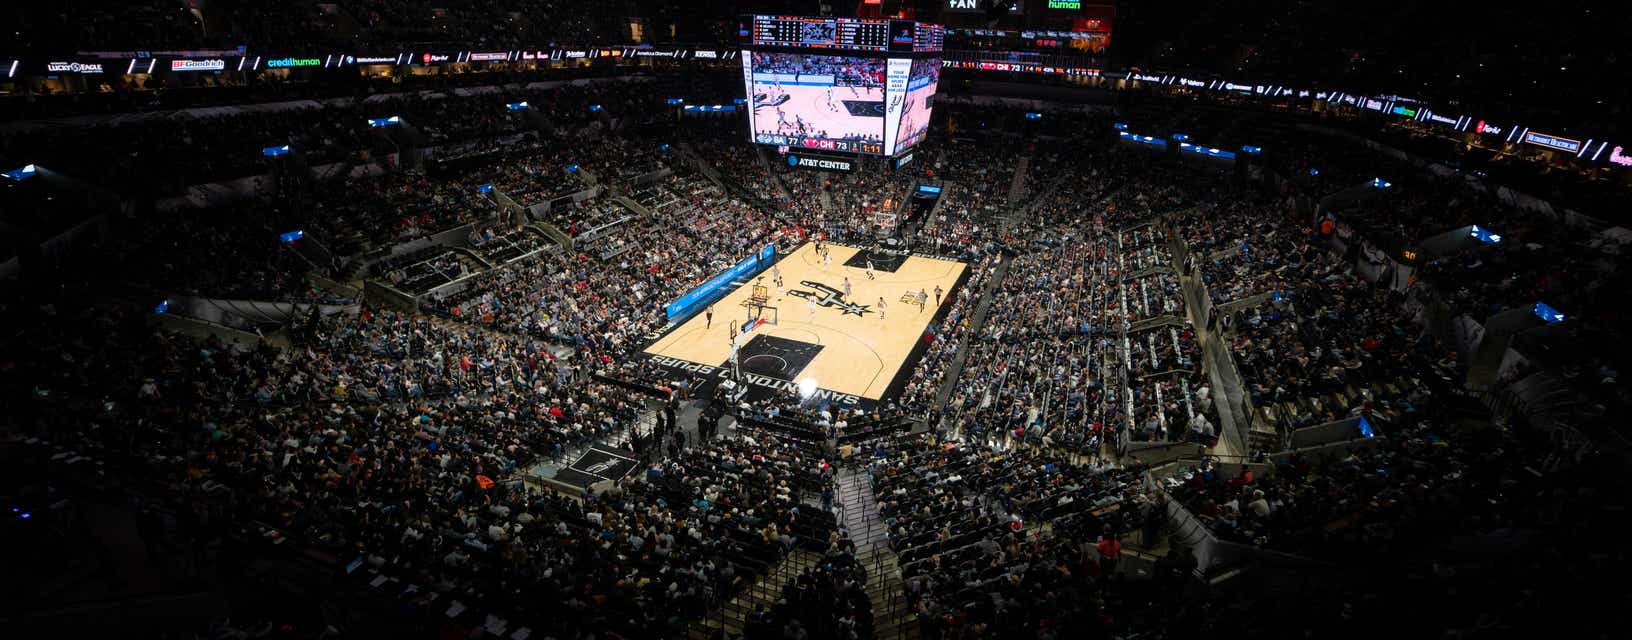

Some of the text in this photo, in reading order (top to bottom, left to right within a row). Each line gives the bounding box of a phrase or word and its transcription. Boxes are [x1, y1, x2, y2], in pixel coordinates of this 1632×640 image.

[1048, 0, 1081, 9] human
[80, 63, 103, 71] EAGLE
[172, 60, 224, 68] BFGoodrich
[267, 58, 321, 67] credithuman
[942, 60, 952, 68] 77
[1011, 64, 1021, 72] 73
[773, 136, 784, 144] SA
[787, 137, 799, 145] 77
[819, 140, 833, 150] CHI
[836, 142, 848, 151] 73
[863, 144, 881, 153] 1:11
[798, 158, 850, 171] AT&T CENTER
[649, 354, 716, 375] SPURS
